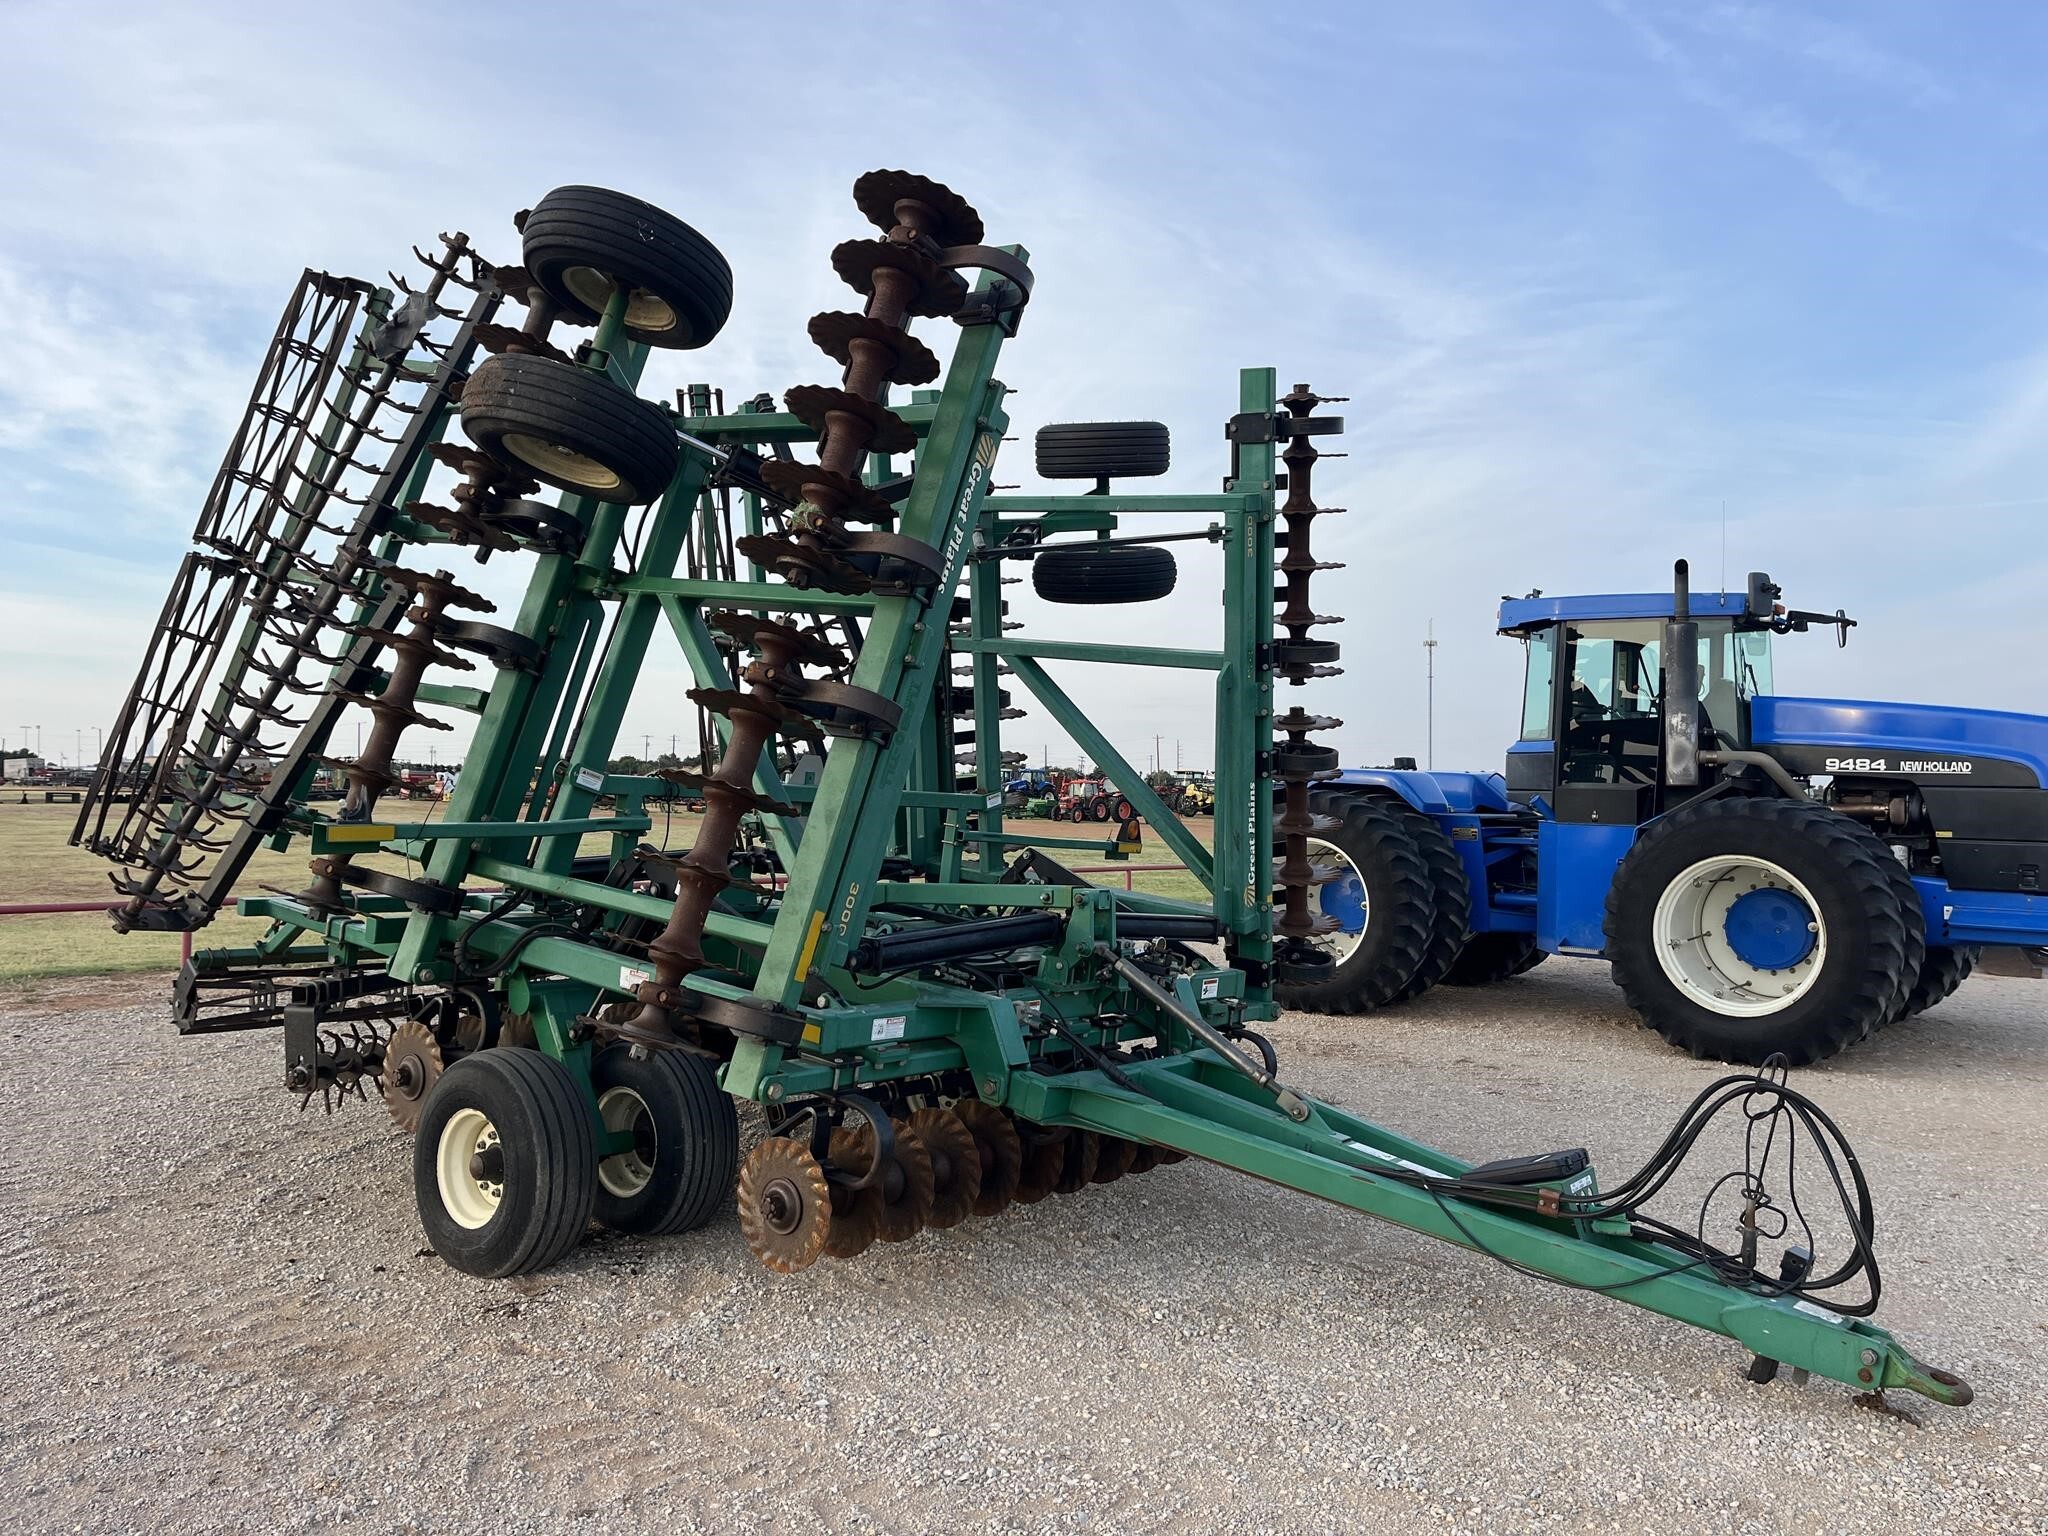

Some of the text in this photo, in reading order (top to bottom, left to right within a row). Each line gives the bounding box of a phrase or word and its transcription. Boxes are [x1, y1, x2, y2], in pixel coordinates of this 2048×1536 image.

[938, 461, 982, 594] Great Plains
[1825, 758, 1972, 772] 9484 NEW HOLLAND
